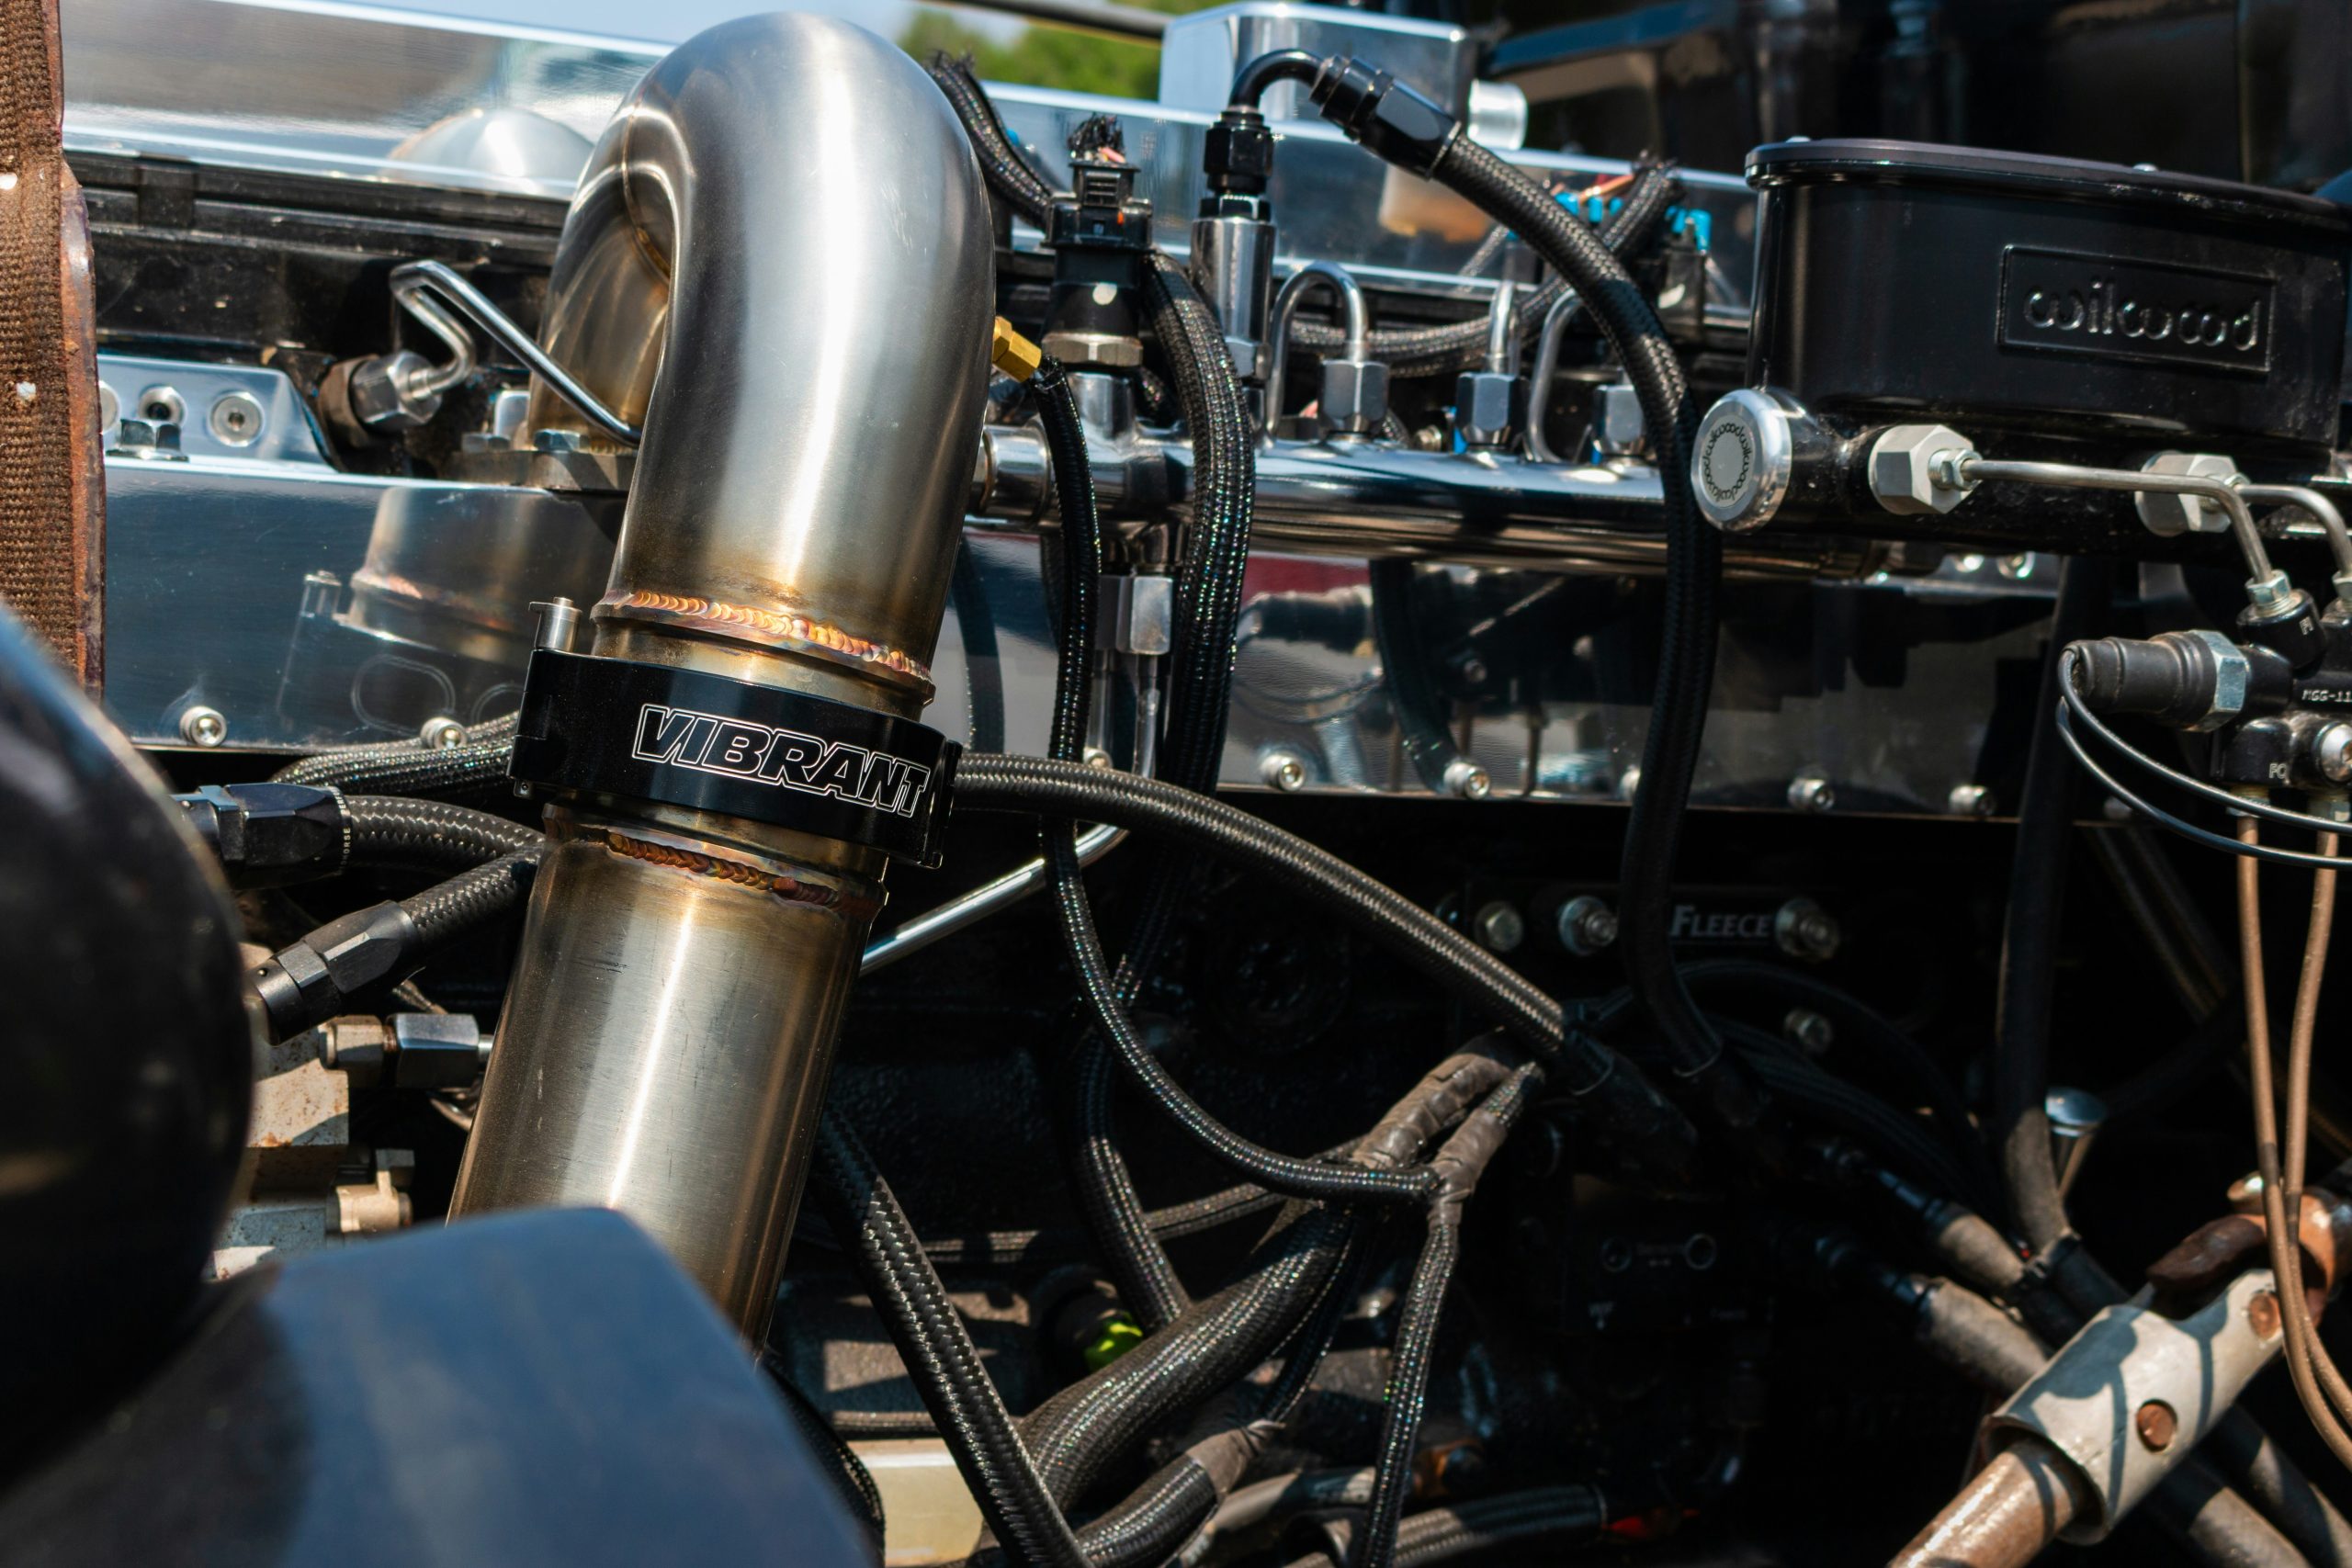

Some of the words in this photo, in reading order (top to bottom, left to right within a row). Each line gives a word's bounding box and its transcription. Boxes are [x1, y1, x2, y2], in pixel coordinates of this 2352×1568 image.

[2023, 280, 2260, 351] wilwood
[632, 704, 931, 818] VIBRANT
[1671, 905, 1772, 937] FLEECE
